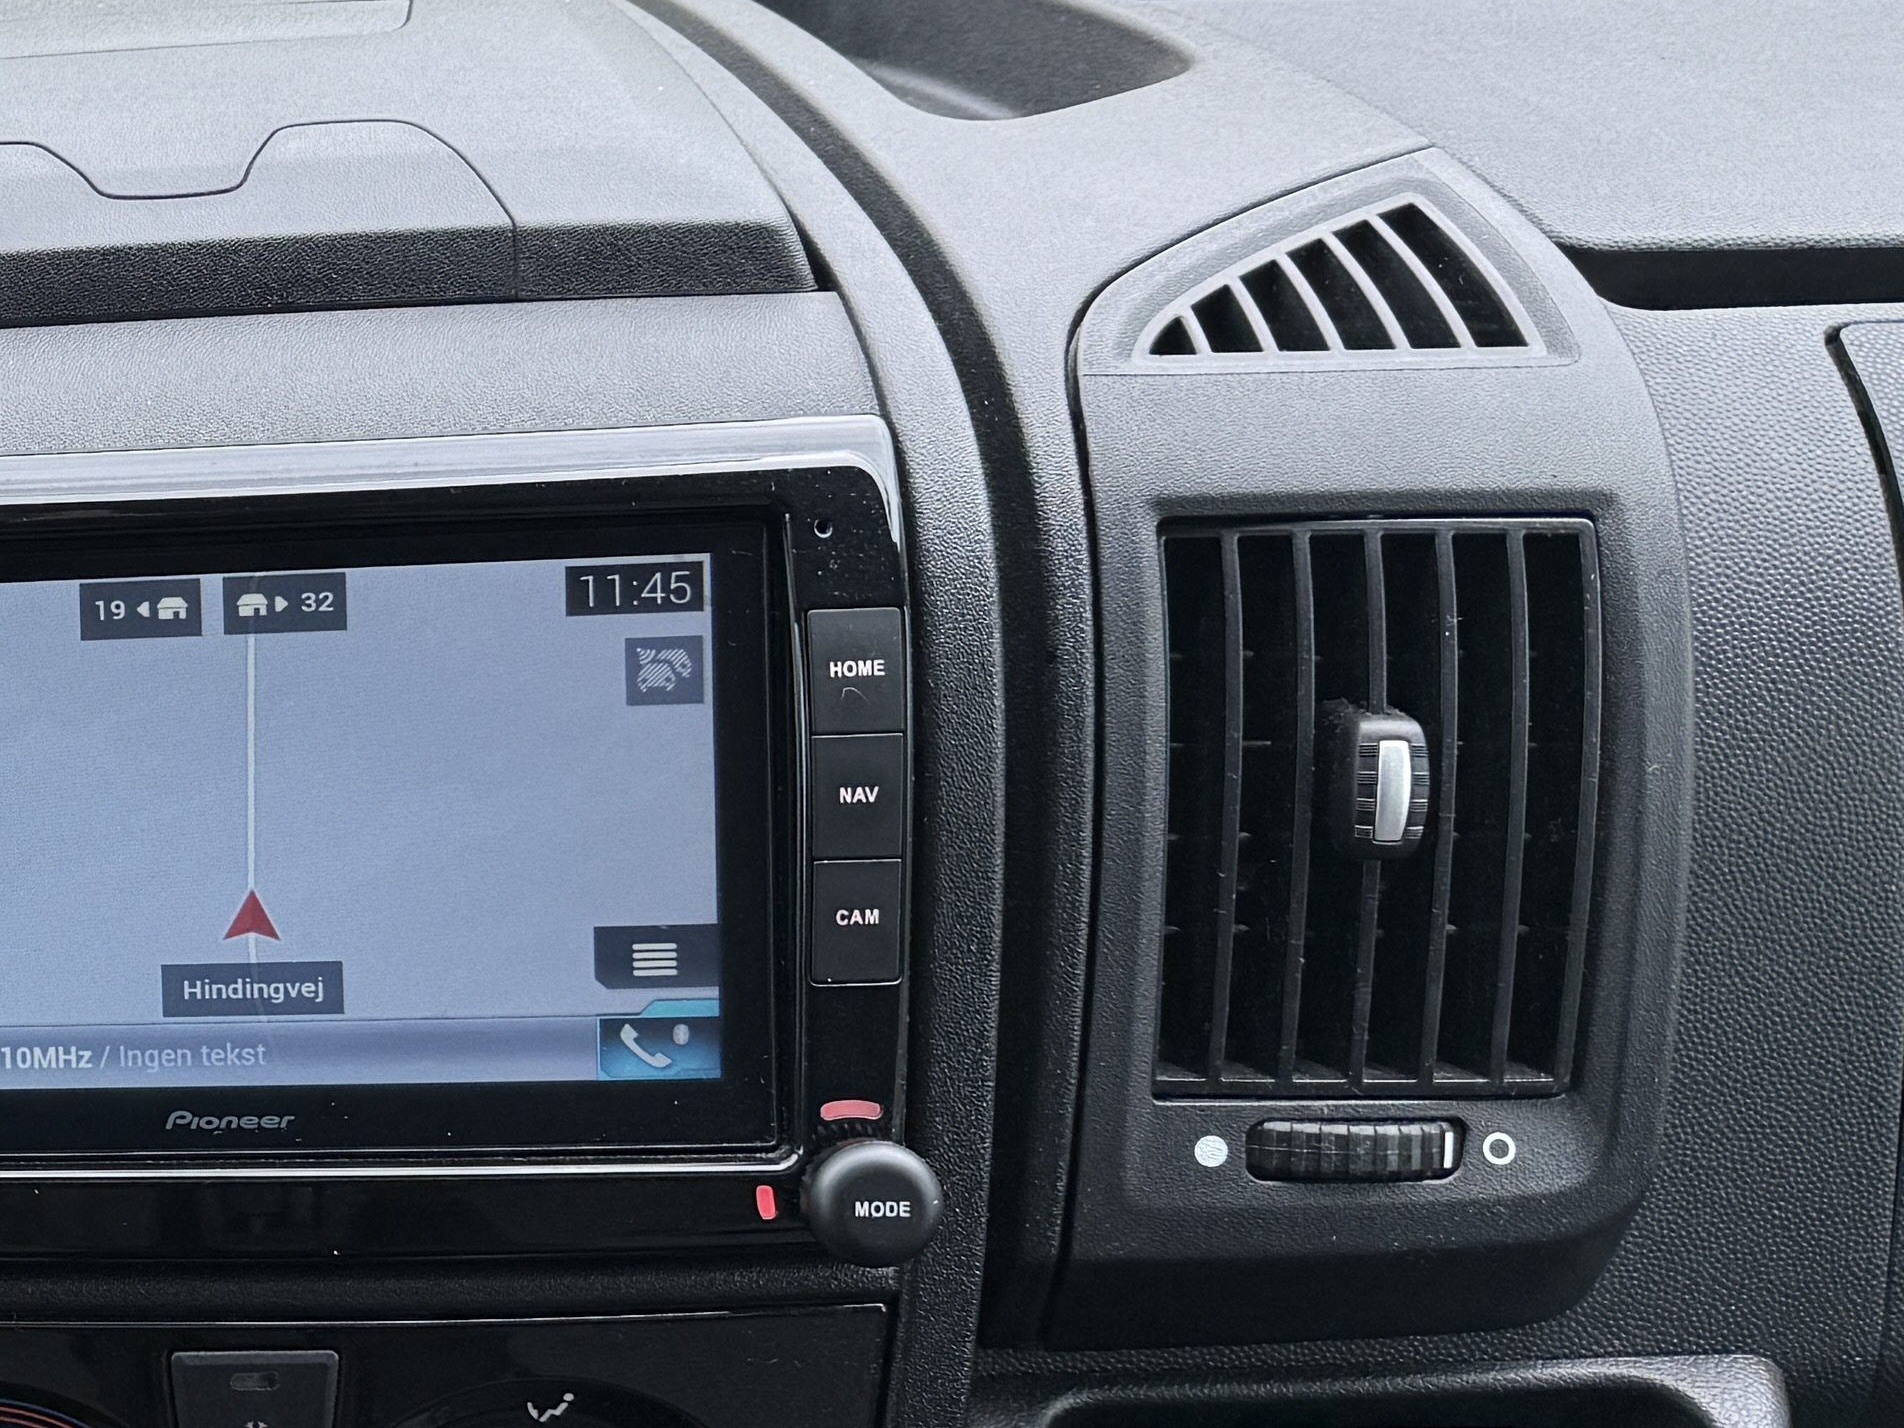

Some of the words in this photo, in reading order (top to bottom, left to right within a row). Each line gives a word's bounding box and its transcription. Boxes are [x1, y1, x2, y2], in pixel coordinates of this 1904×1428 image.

[580, 570, 692, 608] 11:45
[94, 600, 126, 621] 19
[301, 591, 334, 612] 32
[829, 659, 886, 678] HOME
[839, 785, 880, 804] NAV
[835, 908, 880, 926] CAM
[183, 976, 324, 1004] Hindingvej
[119, 1044, 192, 1072] Ingen
[201, 1043, 266, 1068] tekst
[166, 1110, 295, 1130] Pioneer
[854, 1200, 911, 1218] MODE
